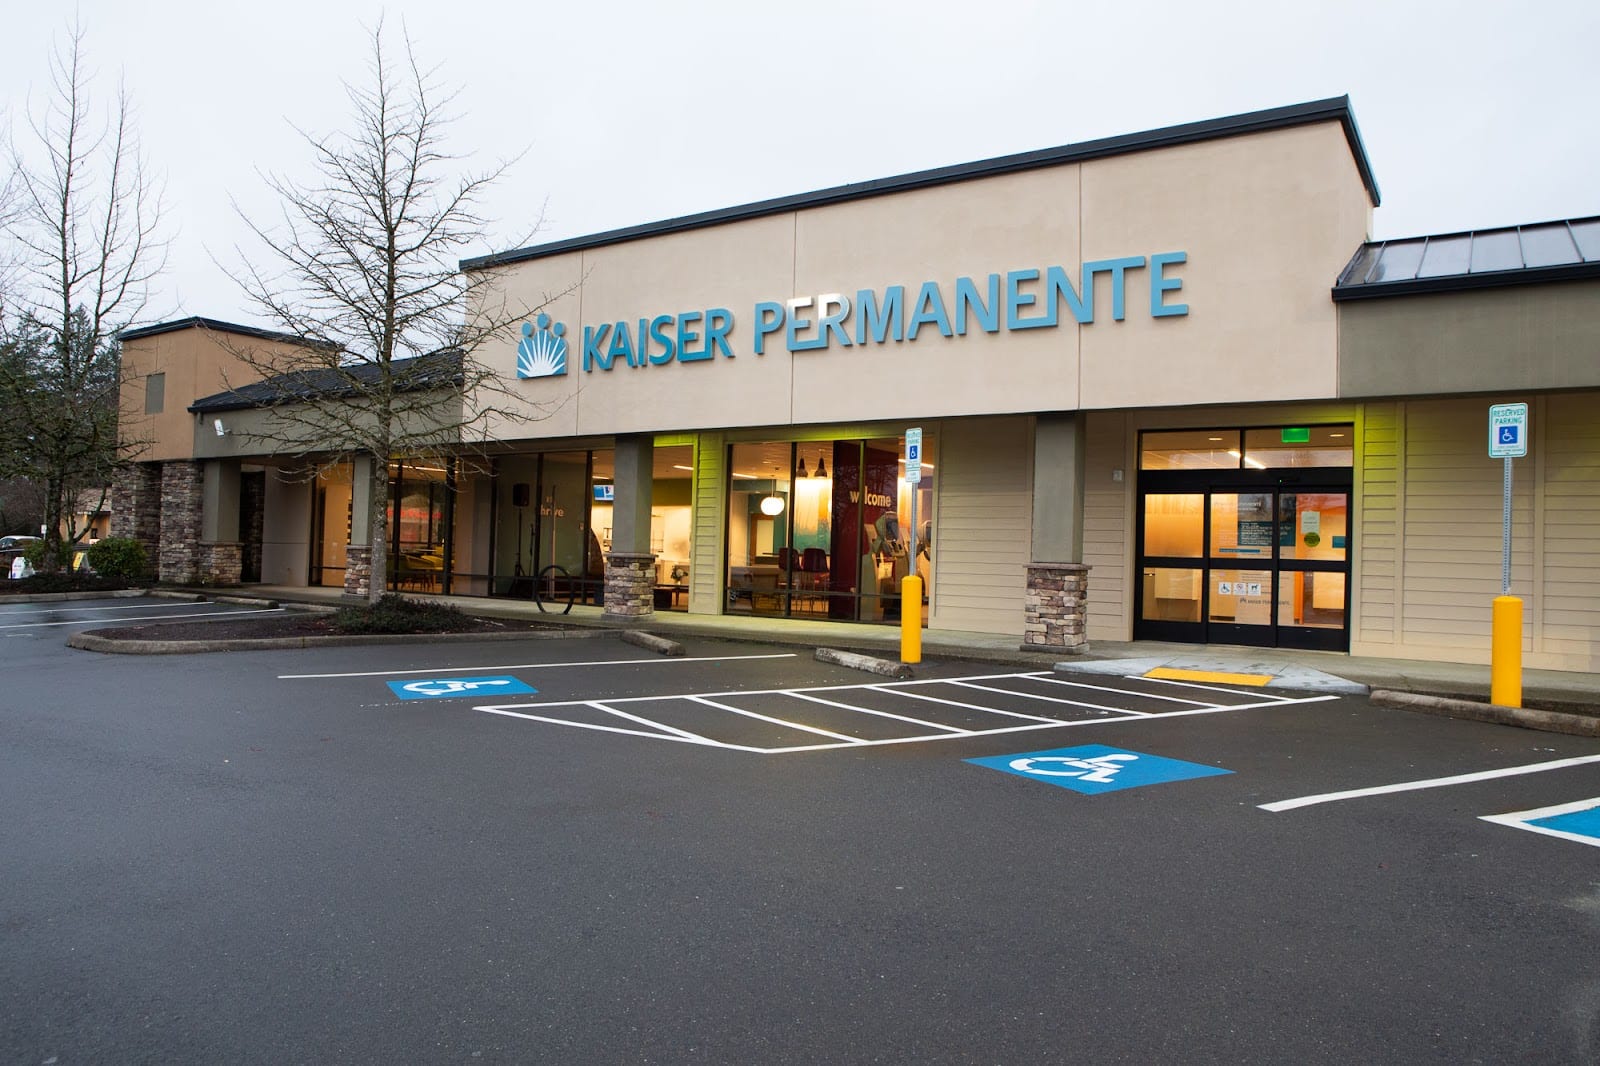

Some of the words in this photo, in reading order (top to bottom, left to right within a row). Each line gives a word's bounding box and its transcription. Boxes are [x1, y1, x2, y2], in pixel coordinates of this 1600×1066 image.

[583, 308, 735, 373] KAISER
[753, 251, 1188, 354] PERMANENTE
[850, 486, 891, 507] wlcome
